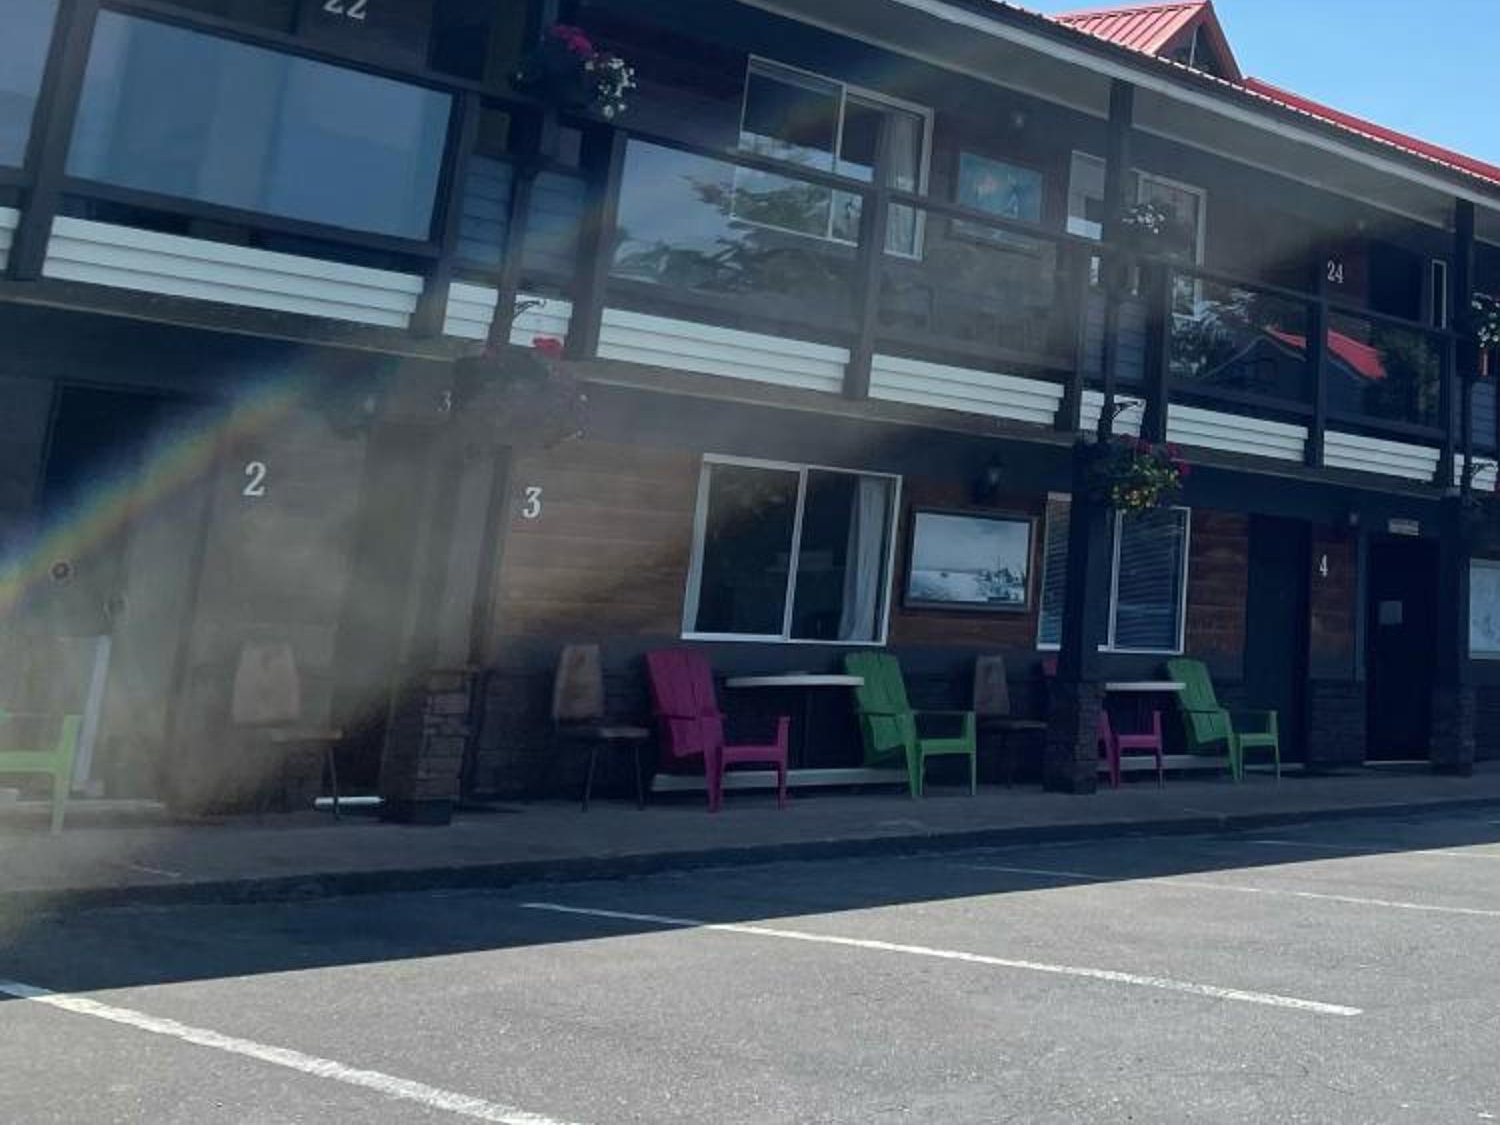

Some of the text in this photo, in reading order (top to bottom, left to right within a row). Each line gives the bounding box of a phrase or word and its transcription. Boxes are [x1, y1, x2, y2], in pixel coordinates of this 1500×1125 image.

[1327, 259, 1344, 284] 24
[243, 461, 266, 497] 2
[523, 486, 543, 518] 3
[1319, 554, 1329, 577] 4
